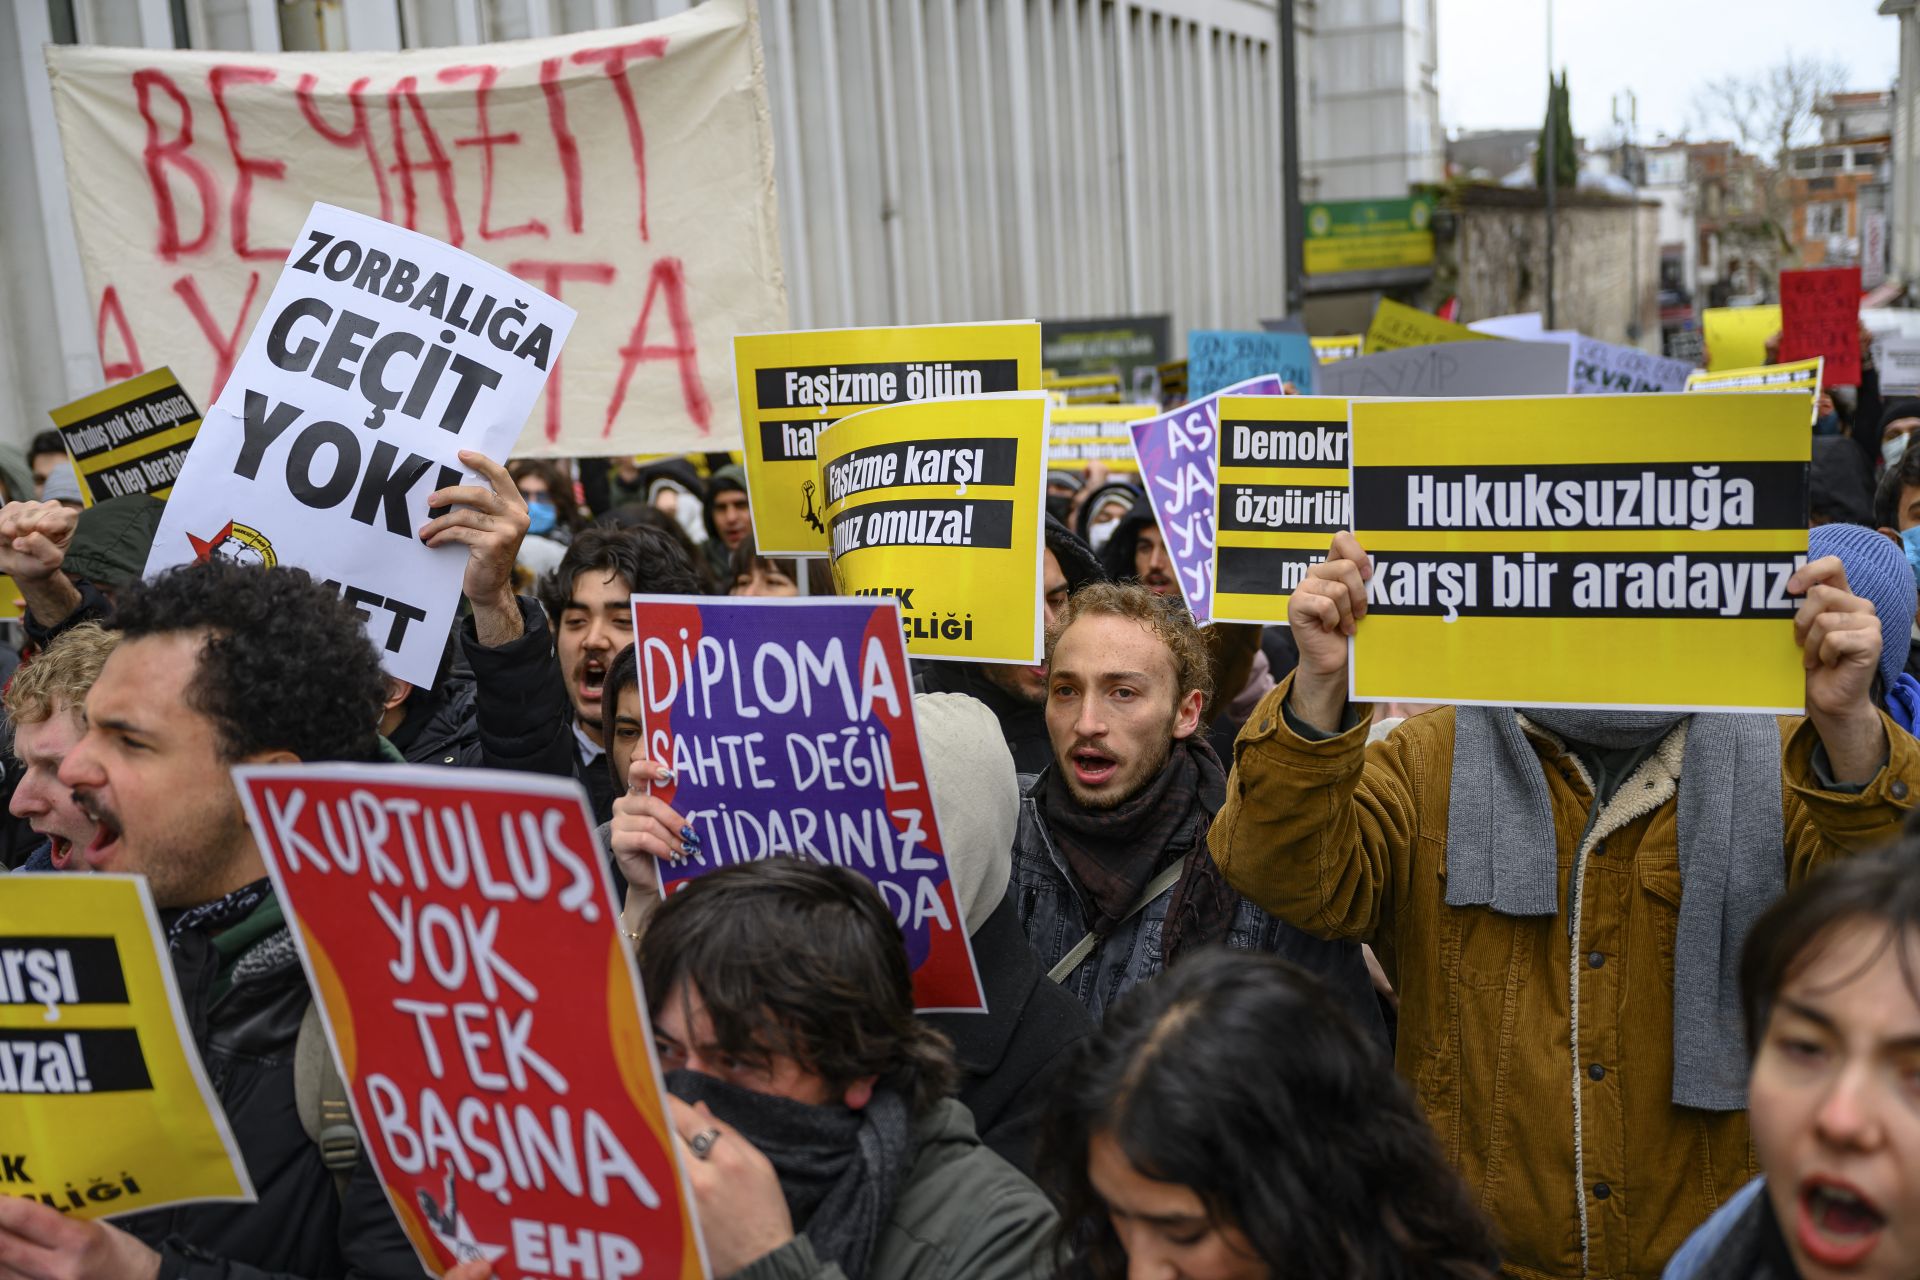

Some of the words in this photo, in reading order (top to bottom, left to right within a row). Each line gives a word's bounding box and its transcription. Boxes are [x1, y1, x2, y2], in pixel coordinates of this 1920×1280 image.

[131, 36, 670, 262] BEYAZIT
[292, 230, 555, 372] ZORBALIĞA
[266, 297, 504, 434] GEÇİT
[785, 367, 898, 415] Faşizme
[906, 363, 982, 400] ölüm
[105, 418, 132, 444] yok
[128, 407, 150, 434] tek
[150, 394, 194, 427] başına
[1233, 425, 1348, 461] Demokr
[101, 473, 124, 498] Ya
[115, 469, 147, 494] hep
[829, 452, 898, 508] Faşizme
[903, 445, 984, 496] karşı
[1408, 465, 1755, 531] Hukuksuzluğa
[866, 505, 974, 546] omuza!
[1366, 554, 1478, 623] karşı
[1493, 552, 1559, 608] bir
[643, 628, 902, 722] DİPLOMA
[651, 729, 776, 791] SAHTE
[786, 726, 920, 792] DEĞİL
[265, 787, 600, 923] KURTULUŞ
[369, 891, 539, 1002] YOK
[393, 999, 570, 1095] TEK
[366, 1073, 661, 1210] BAŞINA
[511, 1218, 644, 1280] EHP
